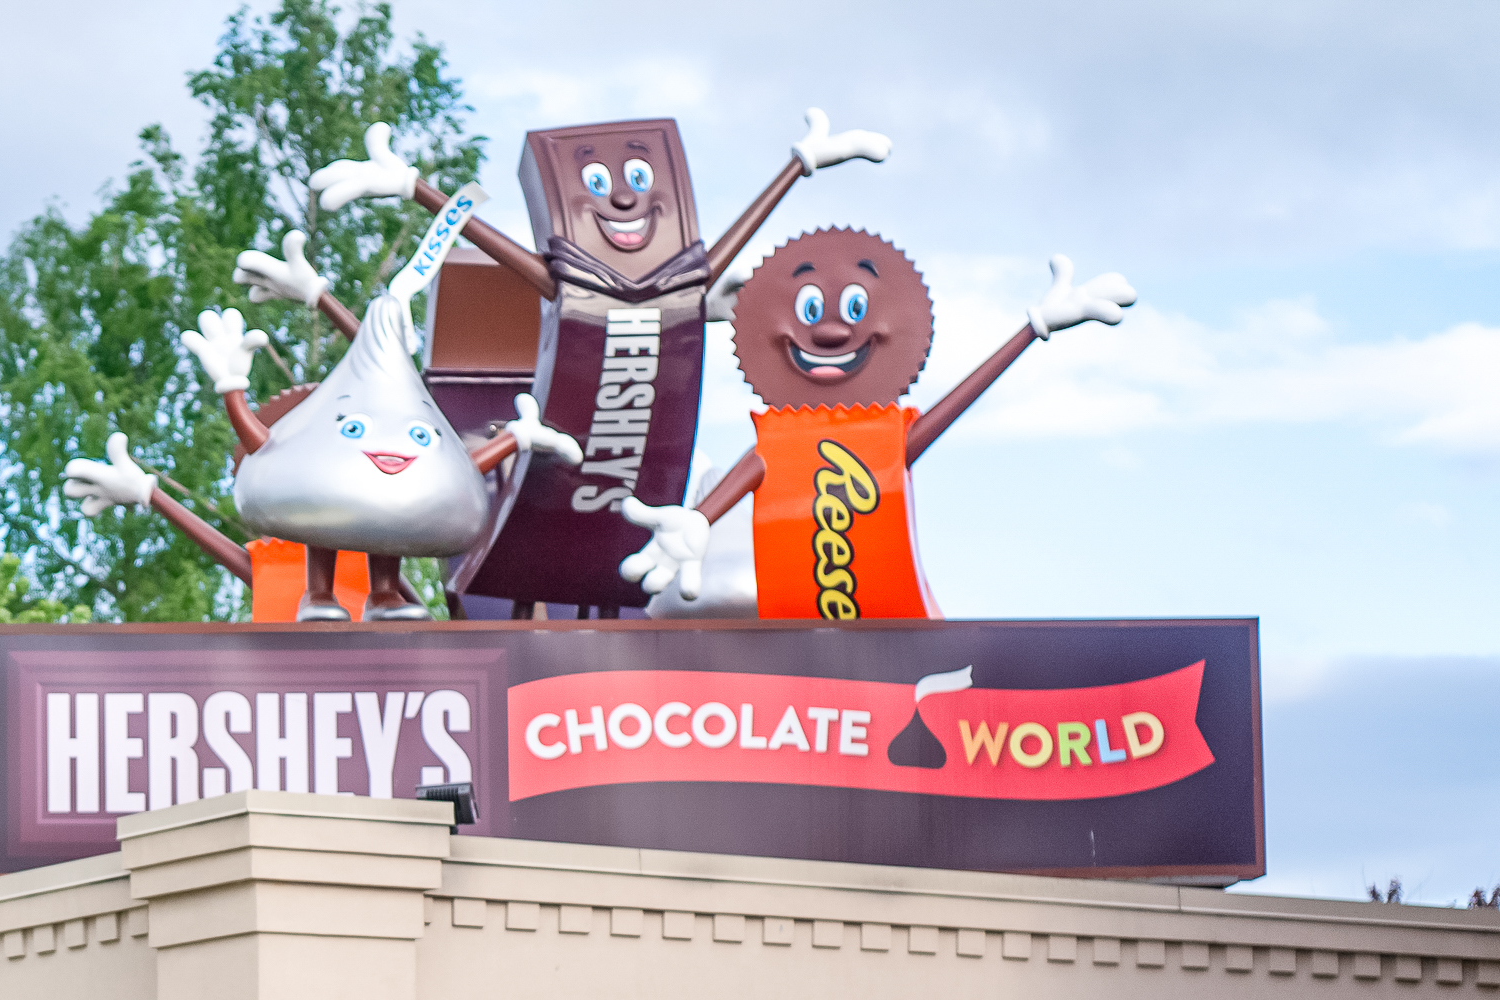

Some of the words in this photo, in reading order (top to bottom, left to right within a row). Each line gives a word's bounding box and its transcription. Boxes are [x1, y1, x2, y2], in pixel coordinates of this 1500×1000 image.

[571, 308, 661, 512] HERSHEY'S
[46, 689, 473, 813] HERSHEY'S
[525, 701, 872, 760] CHOCOLATE
[958, 711, 1166, 769] WORLD
